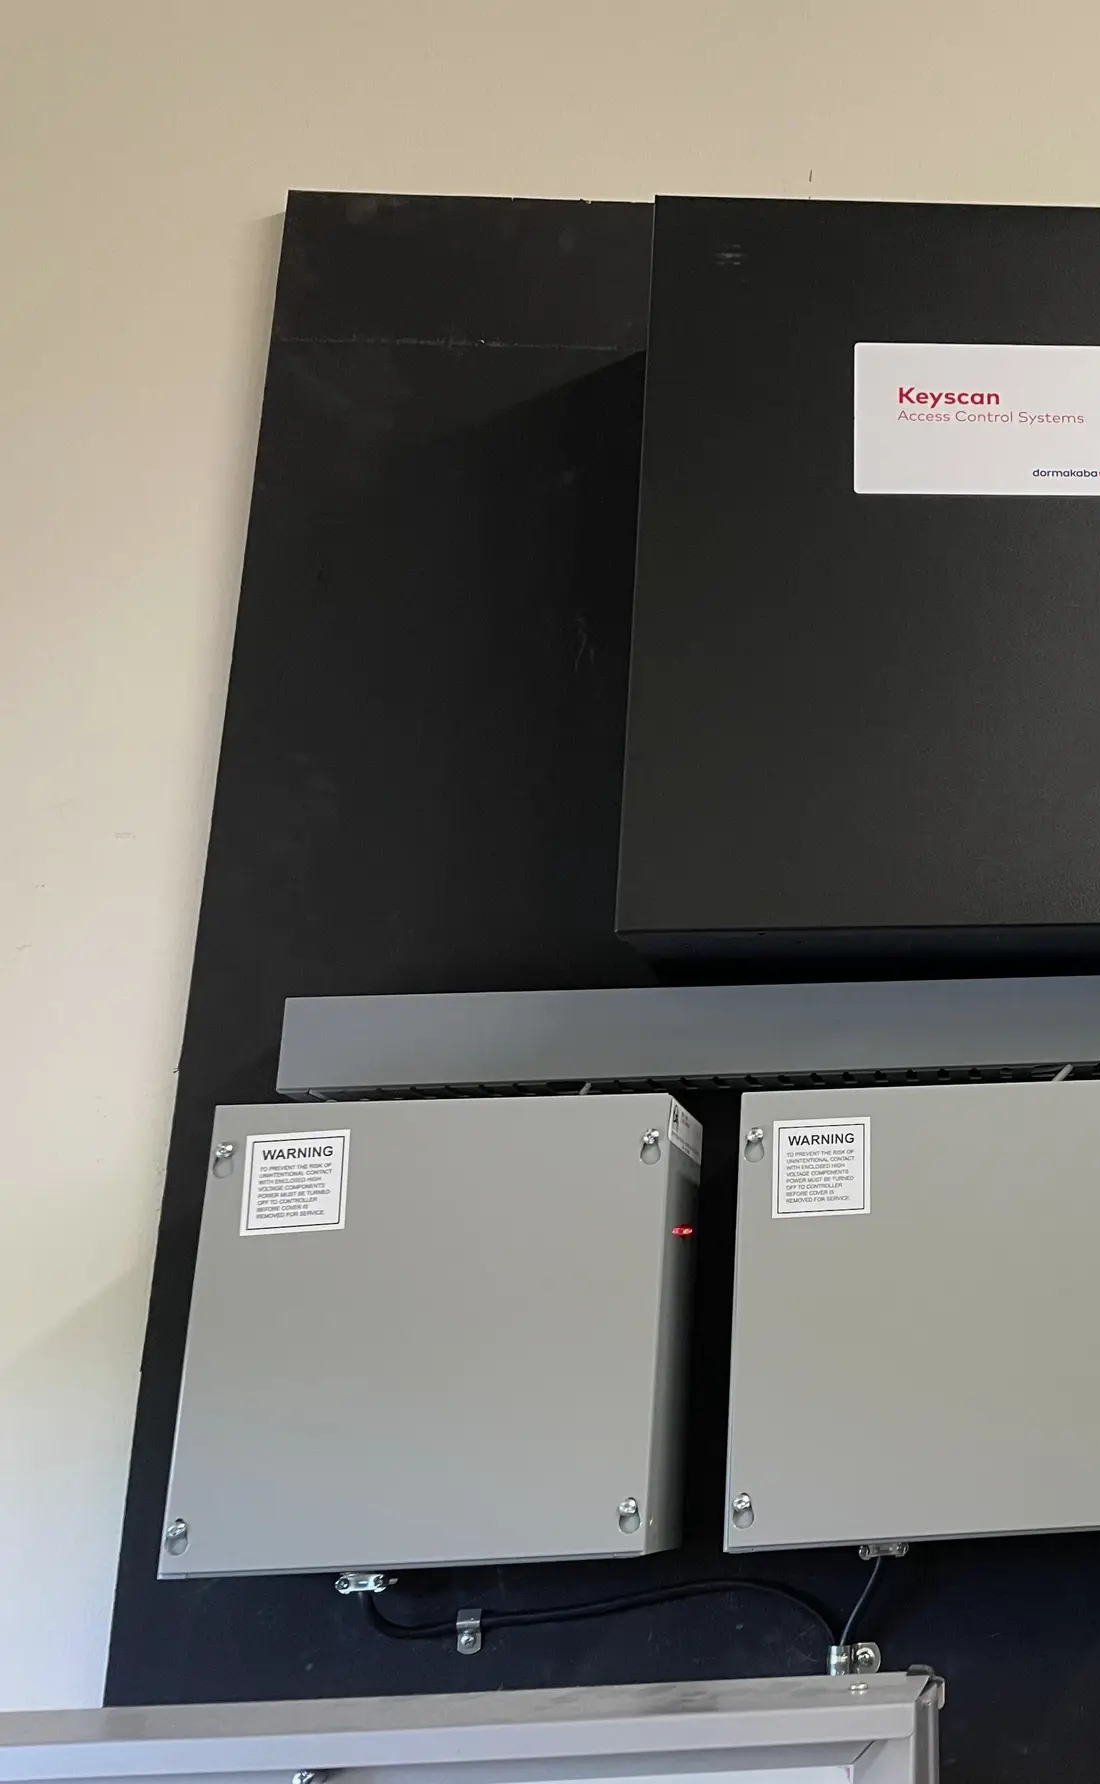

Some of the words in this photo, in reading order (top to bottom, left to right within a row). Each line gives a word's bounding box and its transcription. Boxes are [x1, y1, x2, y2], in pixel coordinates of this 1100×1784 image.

[898, 387, 1000, 408] Keyscan
[898, 410, 950, 422] Access
[955, 410, 1013, 423] Control
[1019, 412, 1084, 425] Systems
[1032, 468, 1098, 478] dormakaba
[788, 1133, 854, 1146] WARNING
[263, 1146, 334, 1160] WARNING
